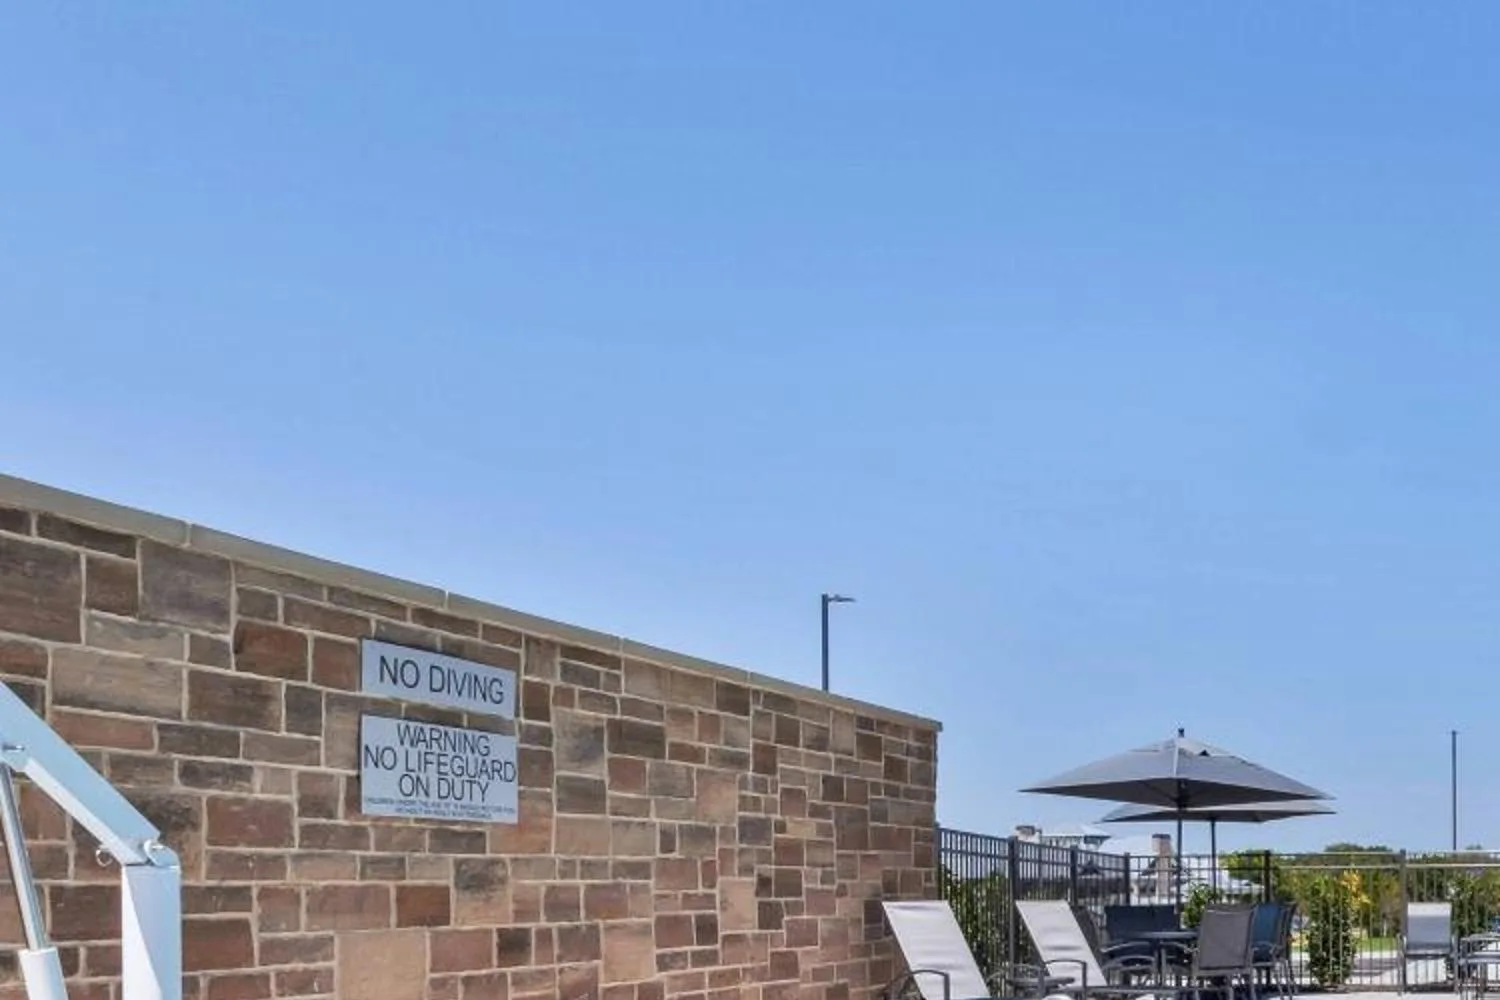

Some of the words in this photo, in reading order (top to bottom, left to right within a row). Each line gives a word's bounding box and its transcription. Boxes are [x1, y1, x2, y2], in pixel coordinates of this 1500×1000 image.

[379, 655, 420, 689] NO
[429, 665, 504, 704] DIVING
[397, 723, 490, 757] WARNING
[364, 745, 397, 770] NO
[405, 750, 516, 783] LIFEGUARD
[399, 774, 430, 798] ON
[437, 777, 490, 802] DUTY
